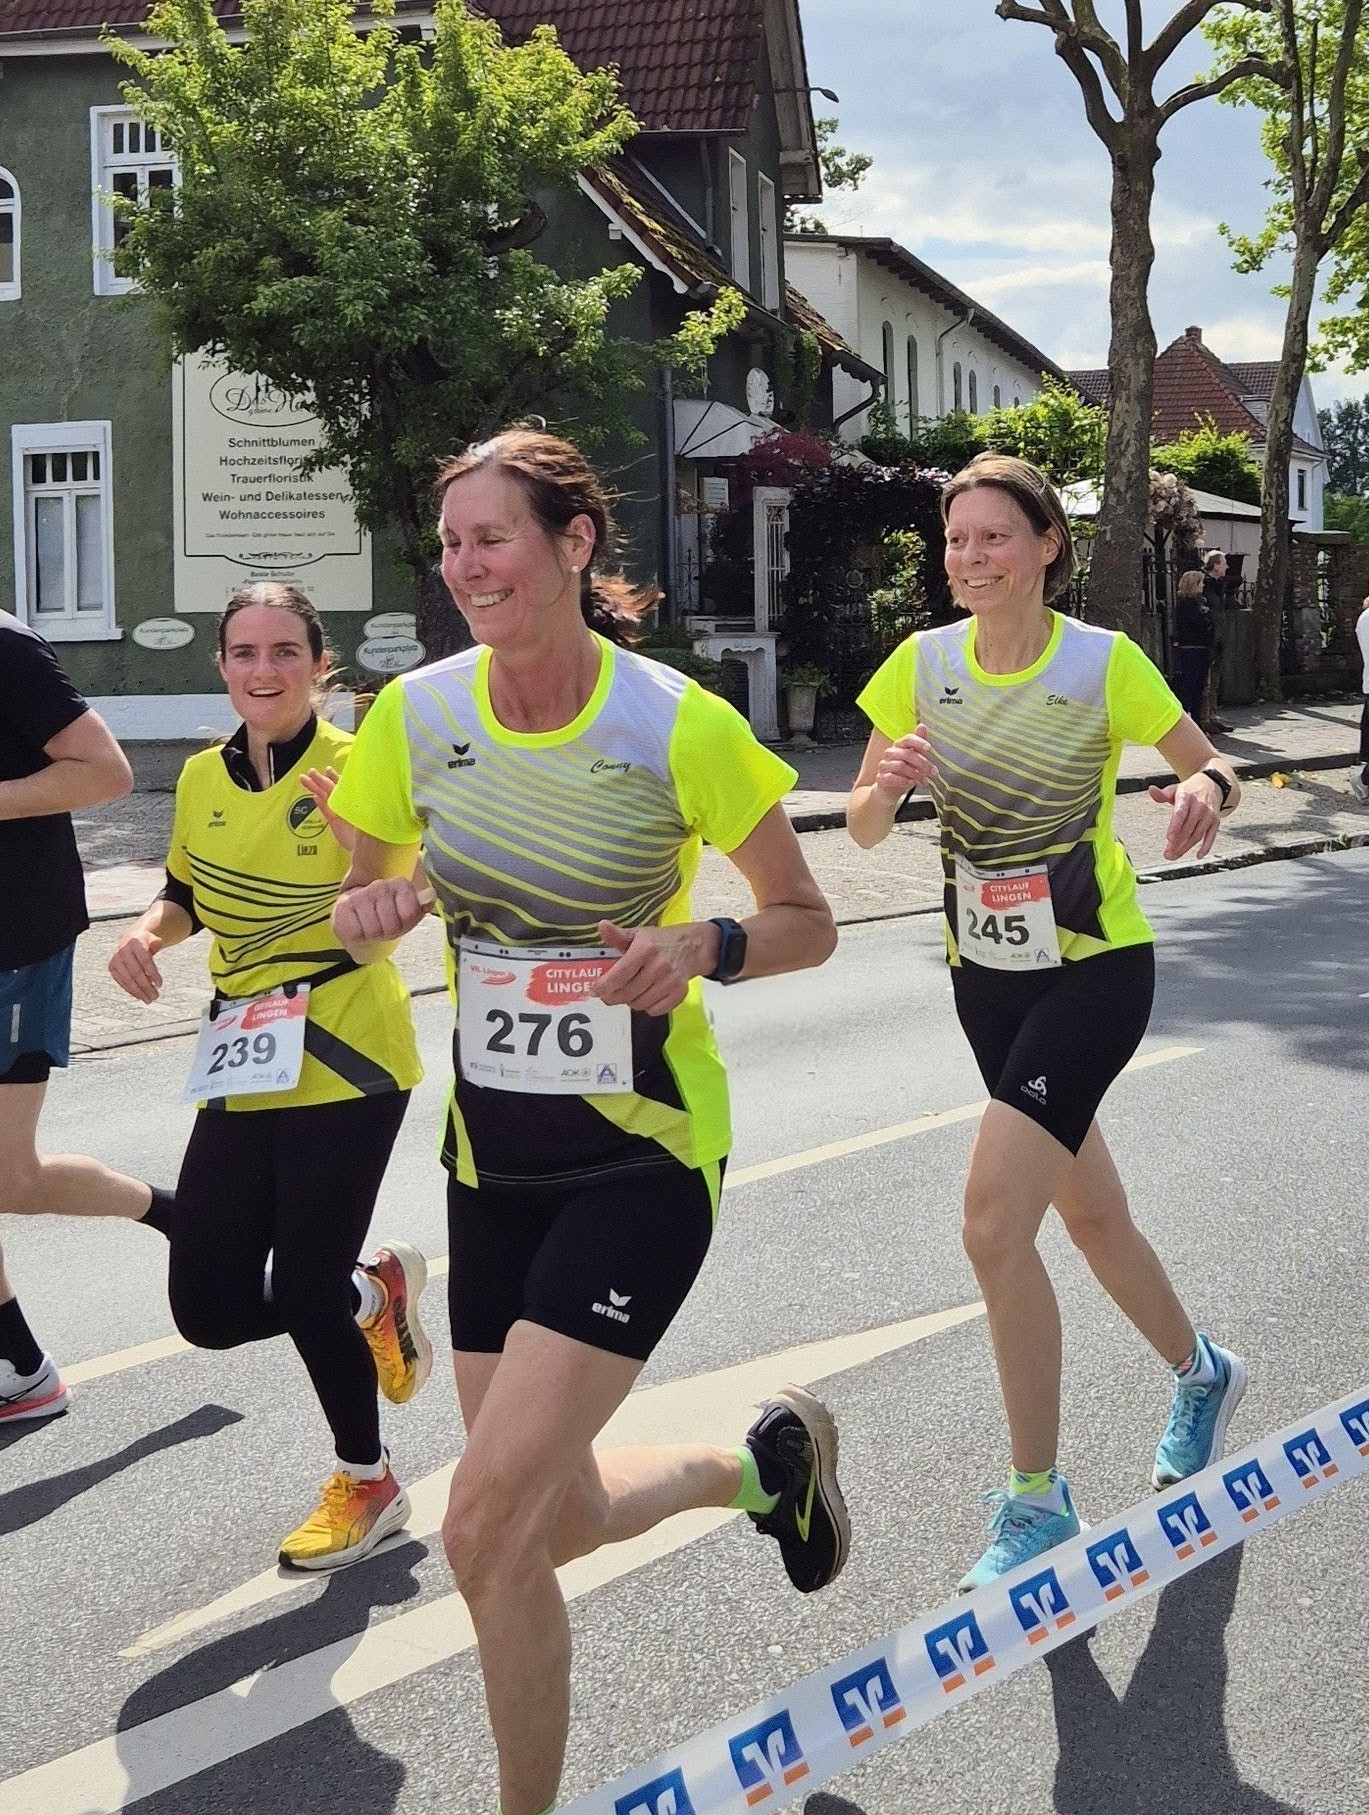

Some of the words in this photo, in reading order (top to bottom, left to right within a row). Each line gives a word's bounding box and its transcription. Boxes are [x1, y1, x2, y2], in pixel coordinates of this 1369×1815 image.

[228, 437, 316, 448] Schnittblumen
[230, 473, 315, 484] Trauerfloristik
[202, 491, 235, 502] Wein-
[239, 491, 262, 502] und
[265, 490, 343, 502] Delikatessen
[219, 508, 326, 520] Wohnaccessoires
[1046, 694, 1069, 706] Elke
[447, 757, 475, 769] erima
[590, 759, 632, 774] Conny
[989, 881, 1030, 892] CITYLAUF
[992, 892, 1032, 903] LINGEN
[965, 907, 1030, 946] 245
[545, 967, 604, 979] CITYLAUF
[547, 981, 593, 993] LINGE
[252, 1008, 288, 1021] LINGEN
[485, 1008, 594, 1058] 276
[206, 1031, 277, 1076] 239
[591, 1302, 631, 1324] erima
